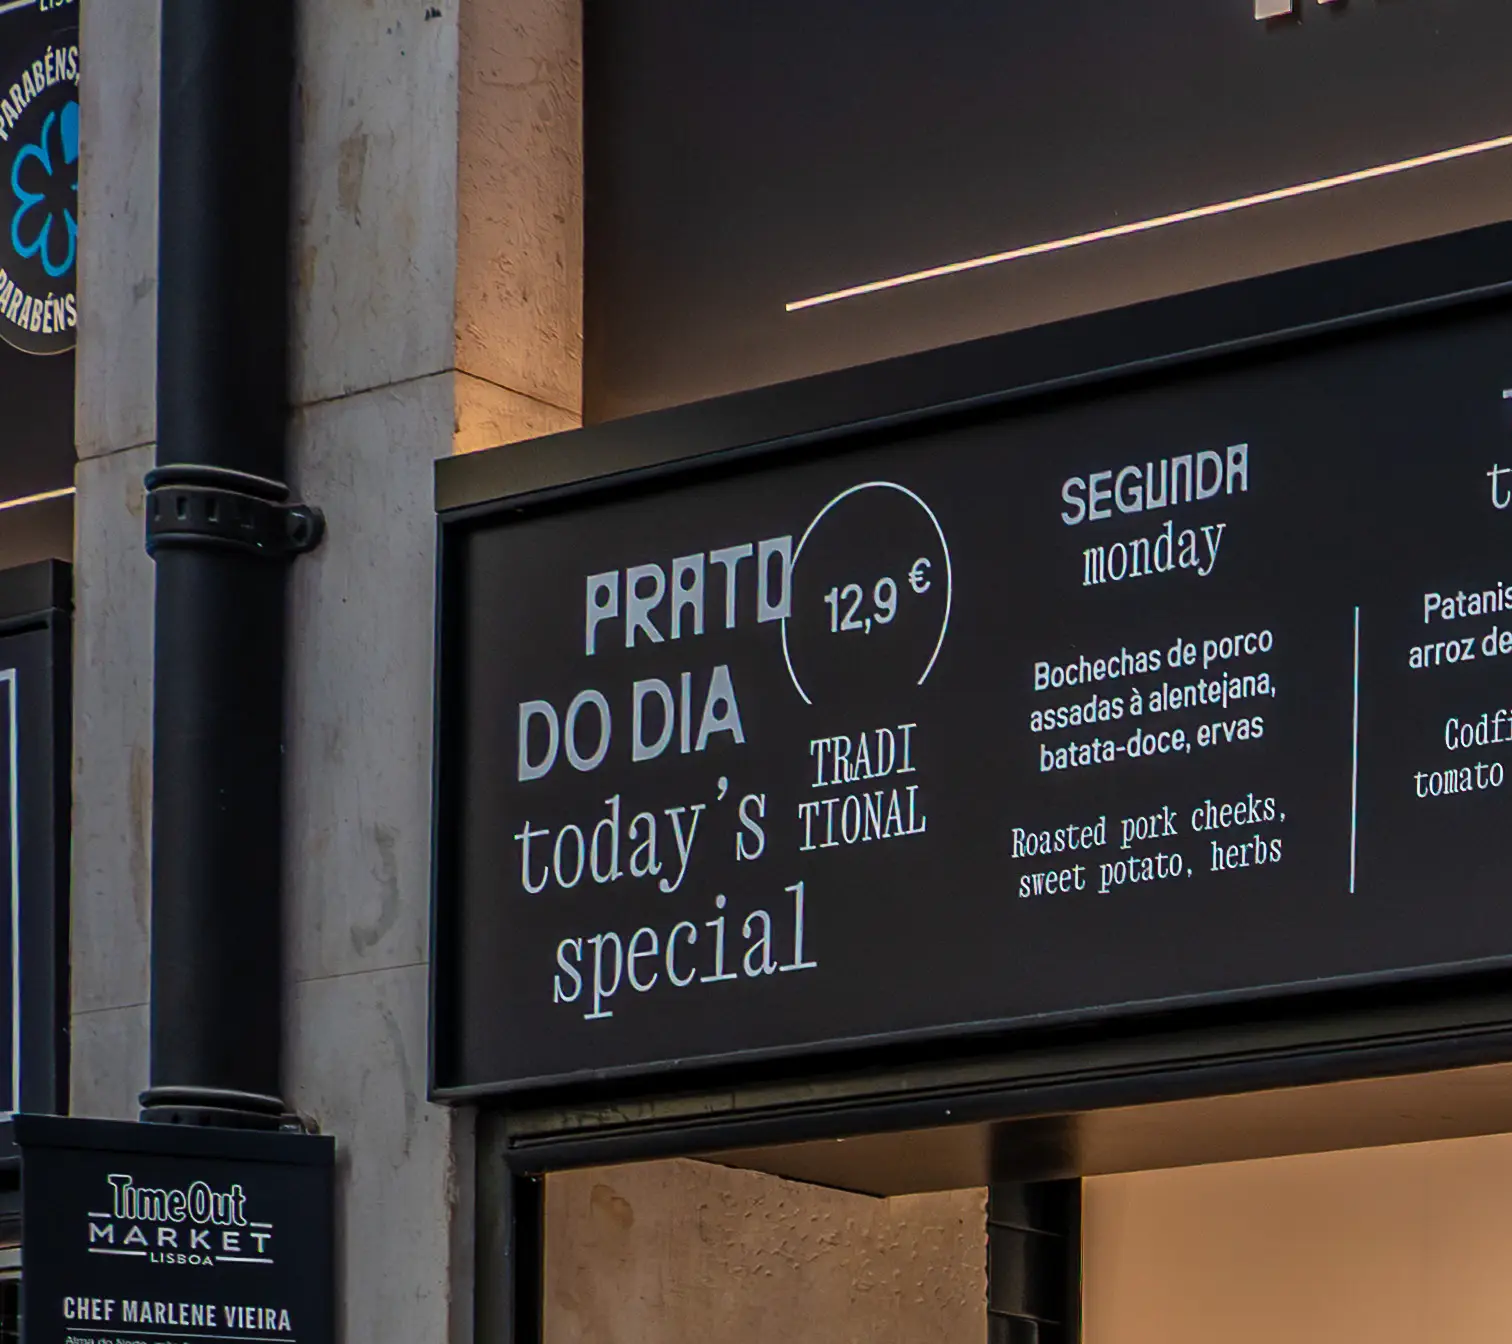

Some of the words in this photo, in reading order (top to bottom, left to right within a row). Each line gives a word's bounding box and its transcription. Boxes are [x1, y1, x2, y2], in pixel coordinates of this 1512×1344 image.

[1061, 443, 1248, 525] SEGUNDA
[1083, 520, 1226, 586] monday
[585, 535, 793, 655] PRATO
[1035, 647, 1161, 691] Bochechas
[1167, 638, 1196, 667] de
[1203, 630, 1273, 669] porco
[1409, 638, 1475, 668] arroz
[518, 689, 611, 782] DO
[632, 664, 745, 762] DIA
[1031, 694, 1124, 732] assadas
[1130, 687, 1142, 715] à
[1149, 672, 1275, 712] alentejana,
[810, 723, 917, 788] TRADI
[1040, 728, 1191, 772] batata-doce,
[1197, 716, 1263, 746] ervas
[514, 776, 765, 894] today's
[799, 785, 926, 851] TIONAL
[1011, 816, 1106, 858] Roasted
[1120, 806, 1178, 849] pork
[1192, 793, 1285, 831] cheeks,
[1019, 864, 1085, 898] sweet
[1098, 852, 1192, 894] potato,
[1210, 834, 1281, 871] herbs
[553, 881, 817, 1020] special
[88, 1222, 272, 1253] MARKET
[150, 1251, 214, 1266] LISBOA
[62, 1296, 115, 1321] CHEF
[123, 1300, 217, 1327] MARLENE
[224, 1305, 292, 1332] VIEIRA
